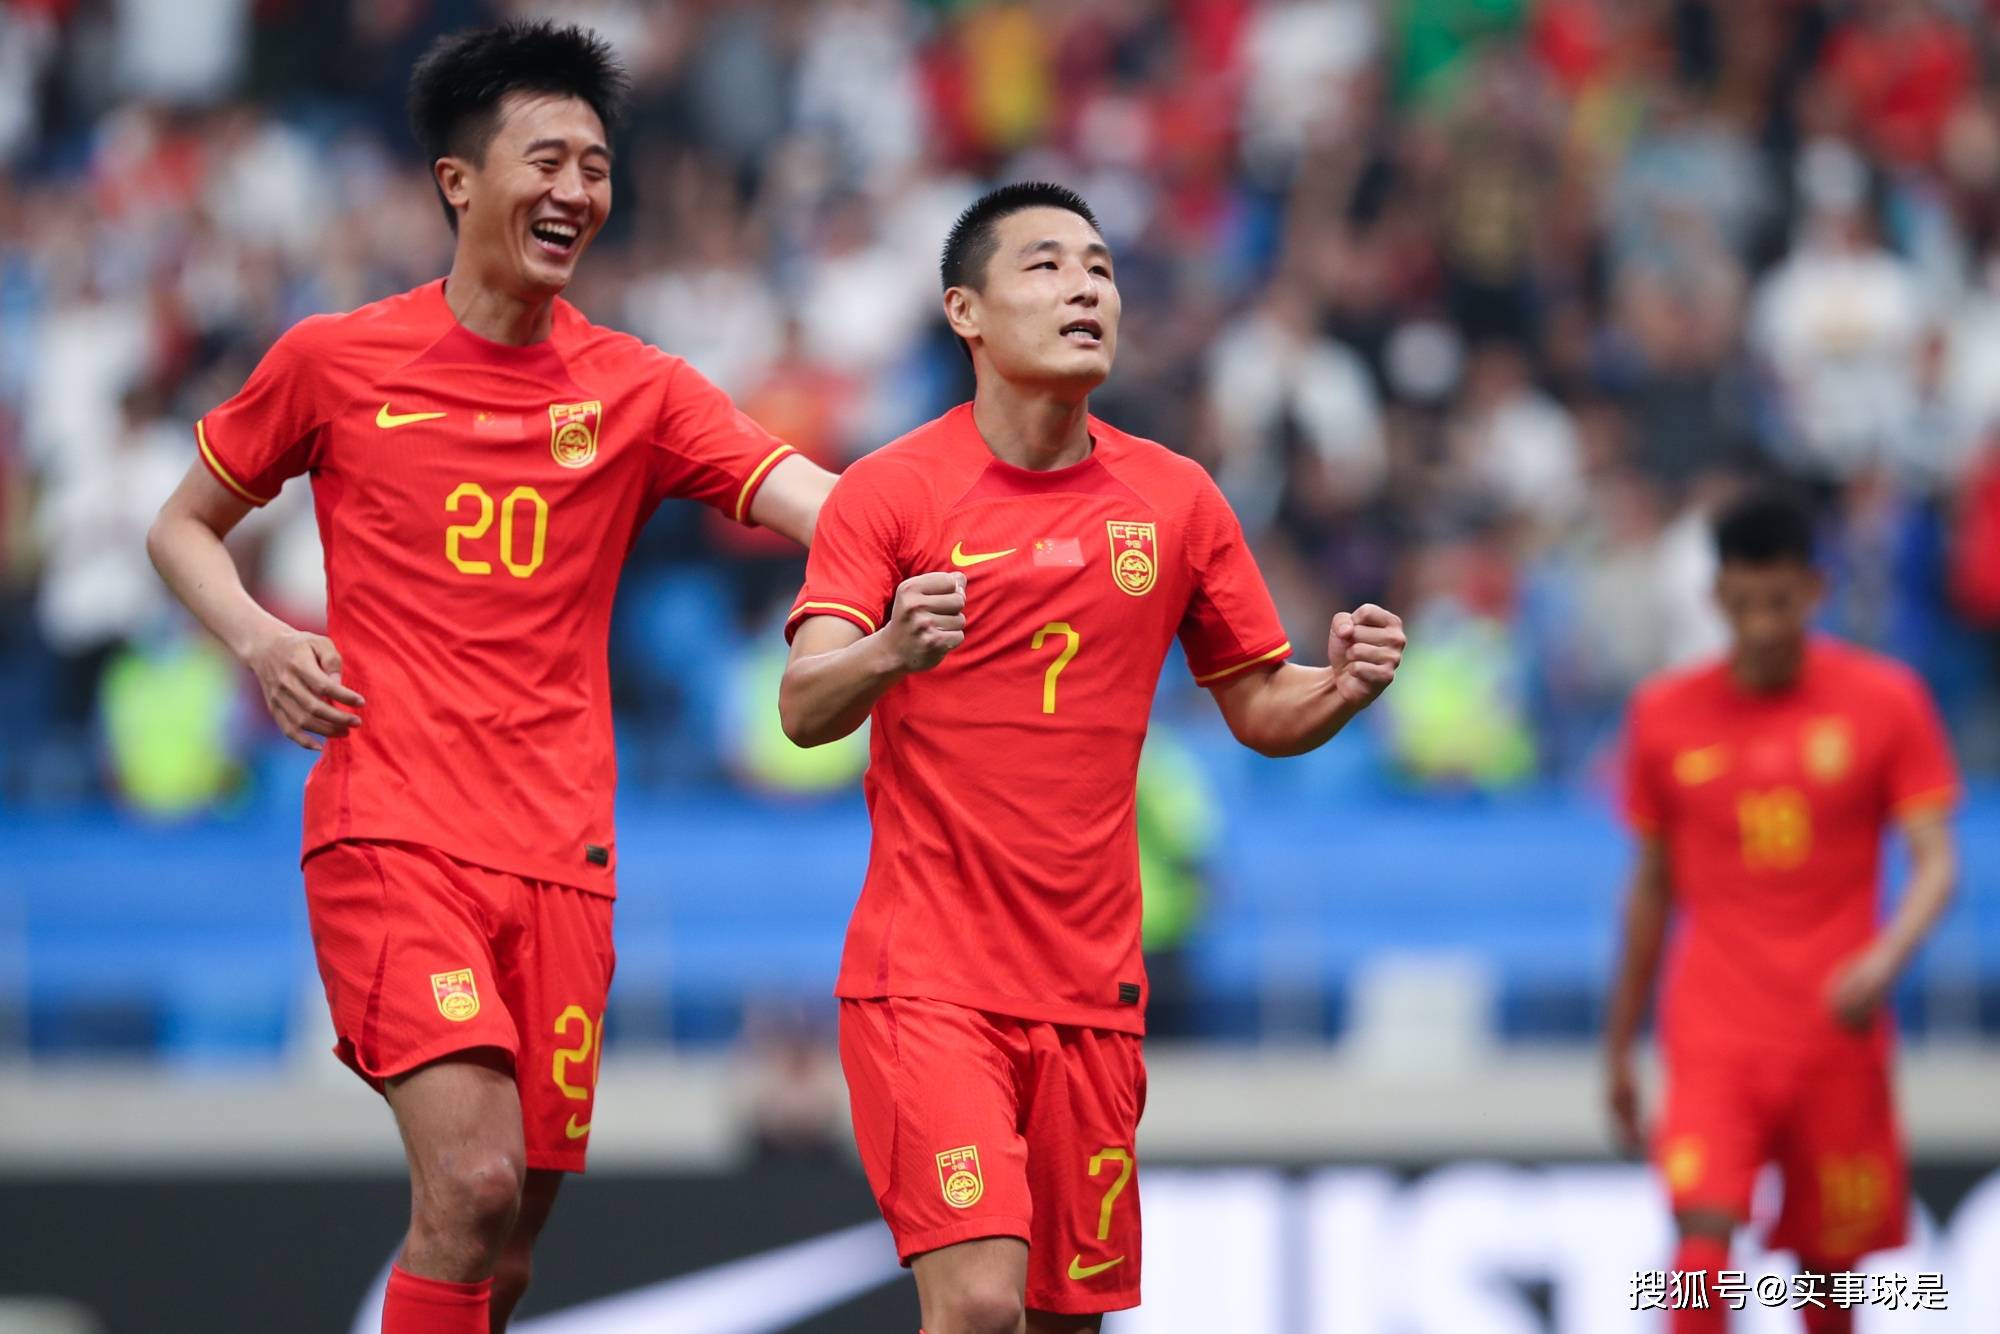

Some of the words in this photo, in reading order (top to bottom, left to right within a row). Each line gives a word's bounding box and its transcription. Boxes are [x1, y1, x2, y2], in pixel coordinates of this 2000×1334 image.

[445, 482, 548, 578] 20
[1111, 525, 1152, 541] CFA
[1031, 622, 1080, 714] 7
[436, 972, 470, 989] CFA
[552, 1005, 604, 1100] 2
[940, 1149, 975, 1168] CFA
[1088, 1148, 1133, 1240] 7
